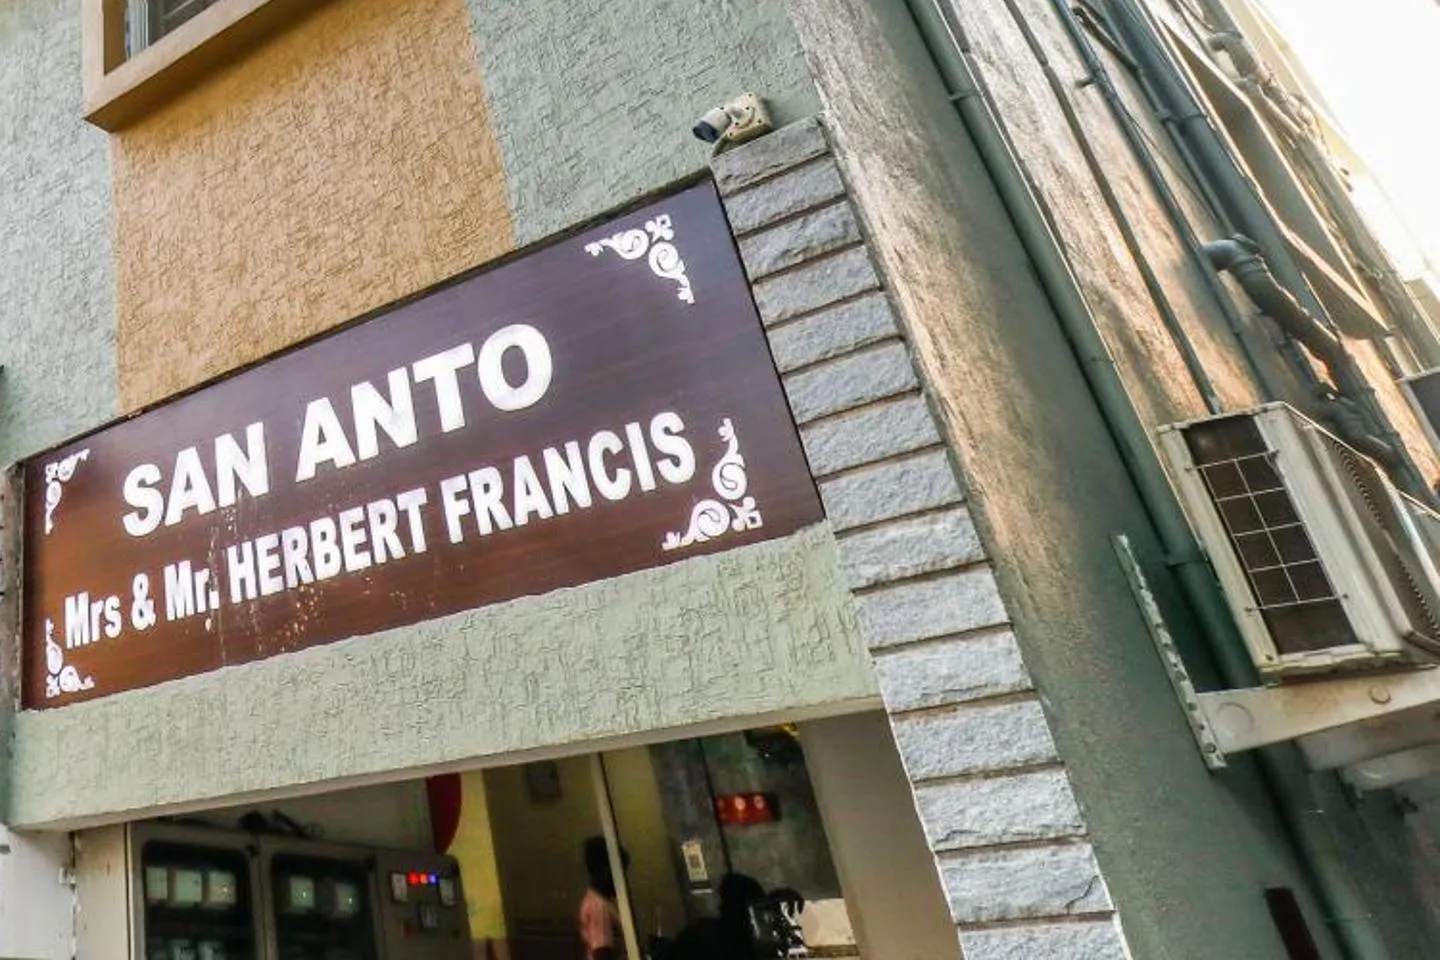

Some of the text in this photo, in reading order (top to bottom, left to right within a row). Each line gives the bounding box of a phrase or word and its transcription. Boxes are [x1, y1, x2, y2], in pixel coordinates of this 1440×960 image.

[64, 591, 122, 649] Mrs
[130, 572, 157, 631] &
[226, 487, 428, 604] HERBERT
[439, 411, 696, 544] FRANCIS
[122, 323, 554, 537] SAN ANTO
